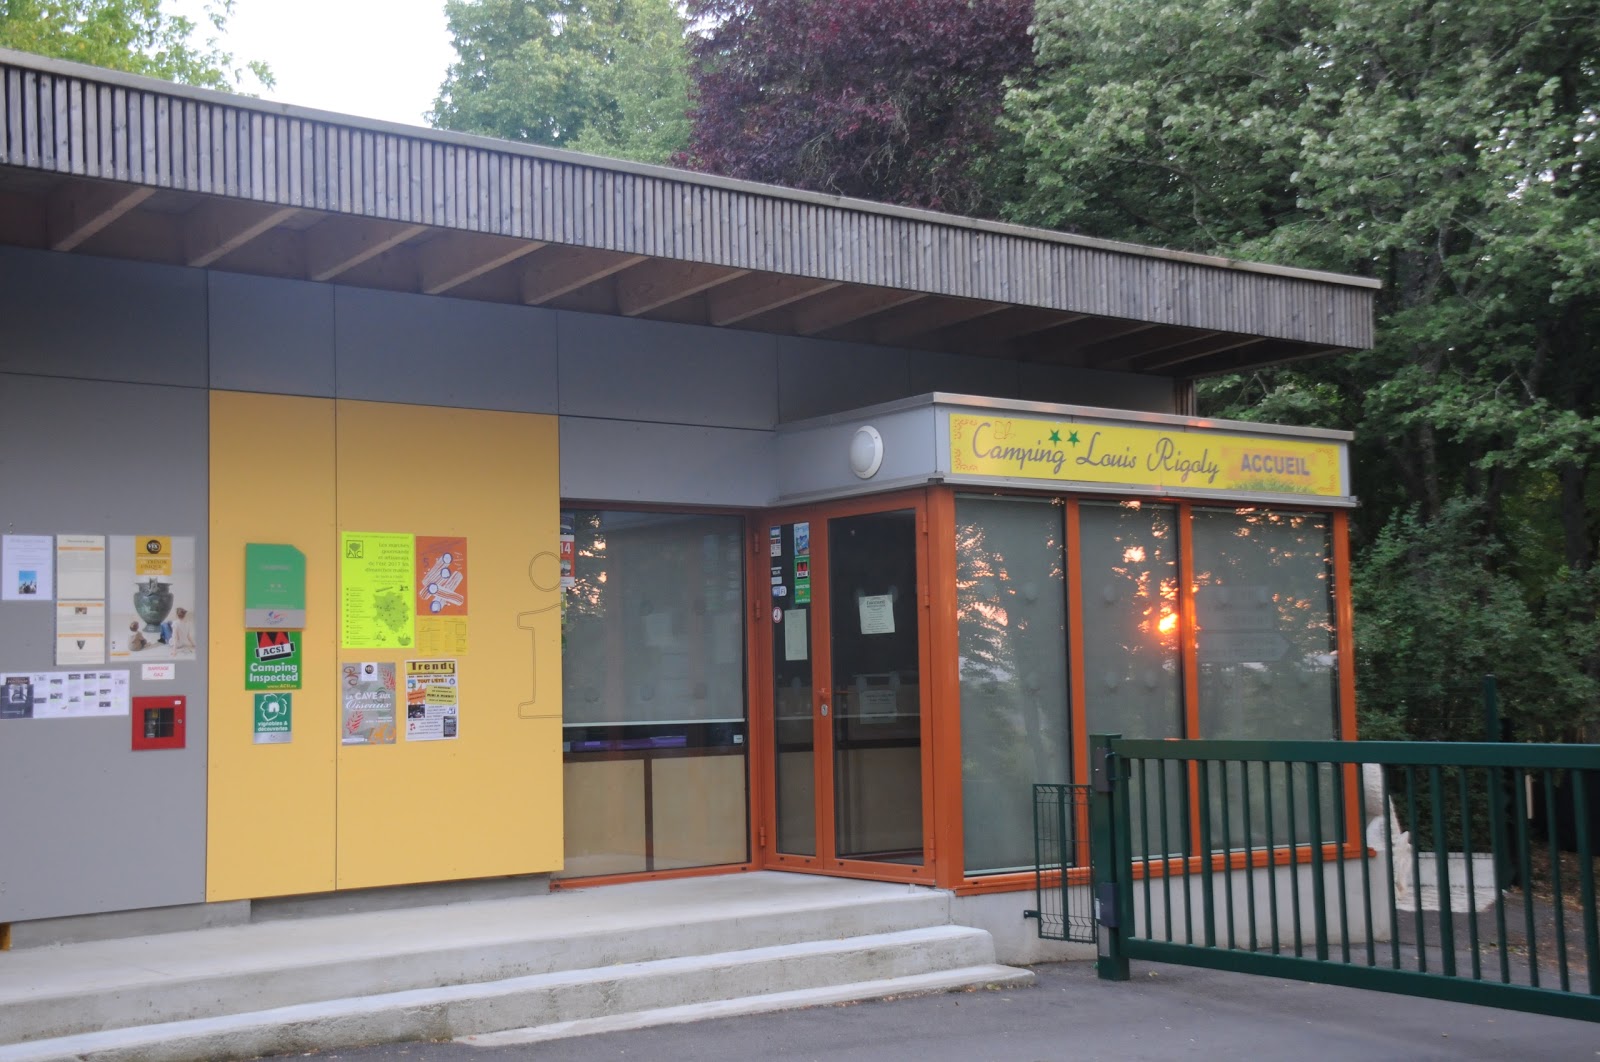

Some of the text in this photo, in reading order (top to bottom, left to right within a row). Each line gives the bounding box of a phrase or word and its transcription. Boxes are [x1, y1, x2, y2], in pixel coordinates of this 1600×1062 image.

[972, 421, 1220, 483] Camping Louis Rigoly
[1240, 453, 1311, 477] ACCUEIL
[250, 662, 297, 673] Camping
[412, 662, 455, 673] Trendy
[249, 673, 298, 683] Inspected
[354, 692, 378, 700] CAVE
[346, 699, 392, 709] Oiseaux
